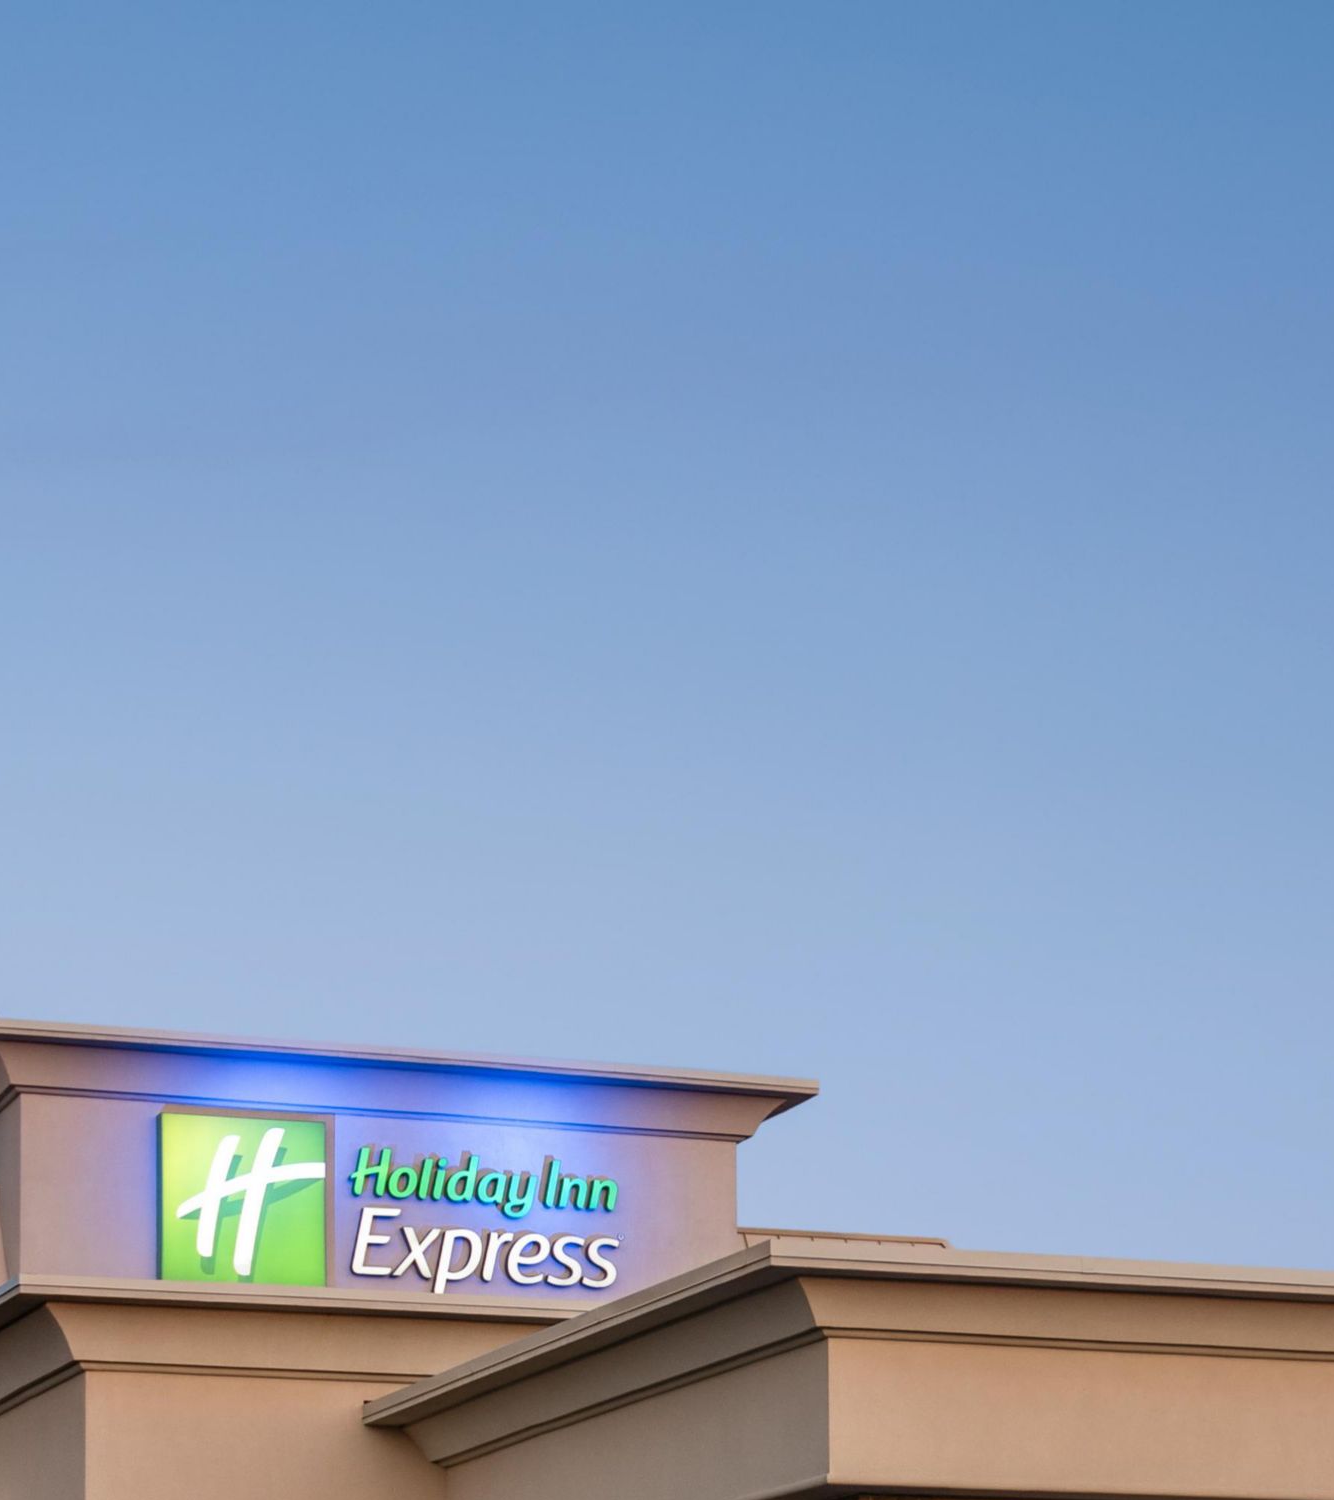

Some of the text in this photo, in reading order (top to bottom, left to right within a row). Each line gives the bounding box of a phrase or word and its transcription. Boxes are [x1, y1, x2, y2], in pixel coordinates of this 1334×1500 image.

[176, 1127, 326, 1276] H
[349, 1146, 619, 1220] Holiday Inn
[350, 1206, 620, 1295] Express
